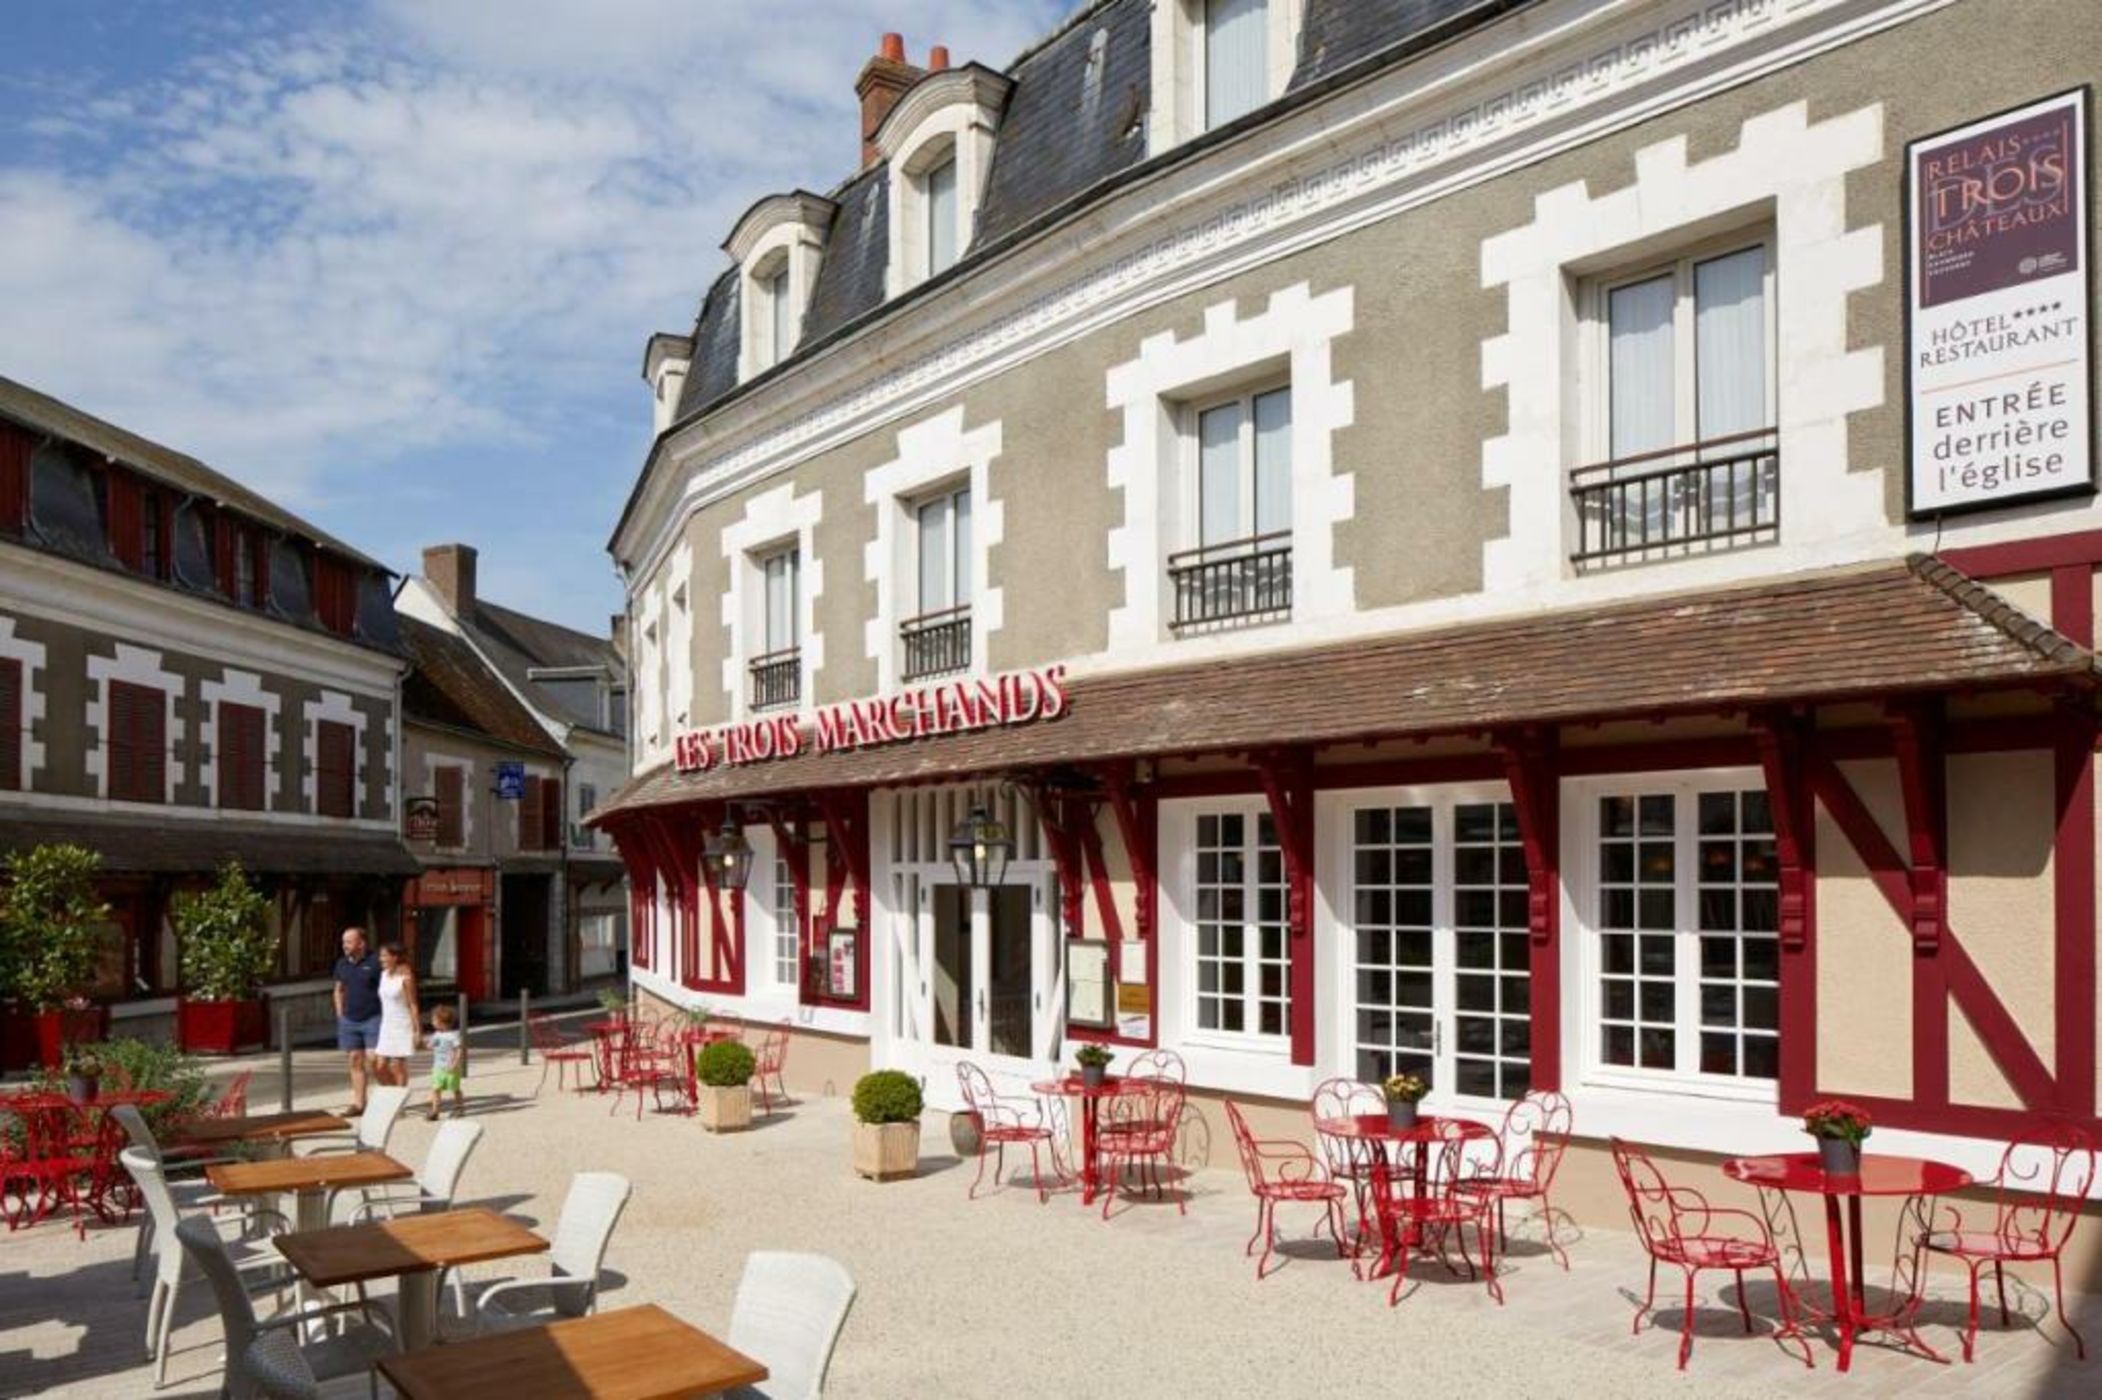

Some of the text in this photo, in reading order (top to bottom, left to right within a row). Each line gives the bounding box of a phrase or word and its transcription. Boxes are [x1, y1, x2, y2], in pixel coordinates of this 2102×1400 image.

[1928, 134, 2021, 179] RELAIS
[1930, 153, 2064, 218] TROIS
[1928, 203, 2062, 250] CHÂTEAUX
[1920, 317, 2078, 368] RESTAURANT
[1932, 314, 2012, 346] HÔTEL
[1936, 381, 2067, 428] ENTRÉE
[1933, 418, 2069, 460] derrière
[1938, 452, 2063, 492] l'église
[674, 665, 1069, 771] LES TROIS MARCHANDS
